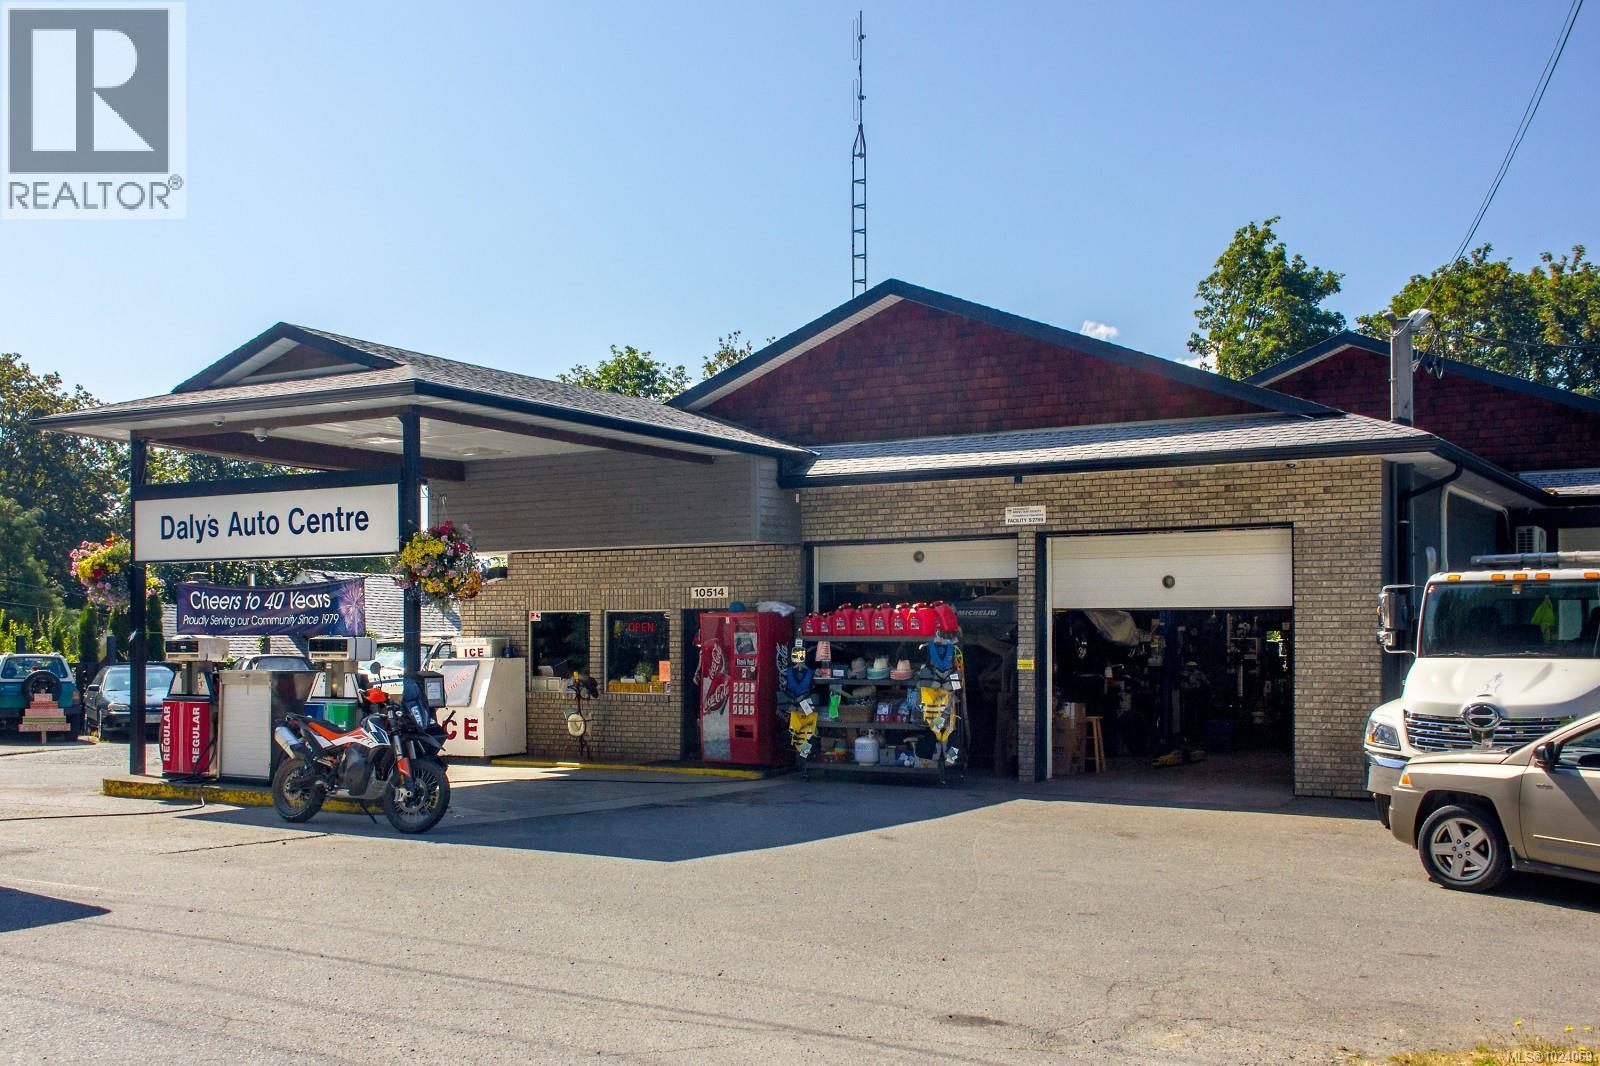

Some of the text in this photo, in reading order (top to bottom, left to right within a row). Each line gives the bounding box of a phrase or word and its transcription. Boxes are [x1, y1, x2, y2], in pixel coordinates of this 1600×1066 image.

[160, 506, 369, 544] Daly's Auto Centre
[190, 591, 331, 610] Cheers to 40 Years
[694, 588, 725, 598] 10514
[183, 613, 339, 628] Proudly Serving our Community Since 1979
[628, 622, 655, 633] OPEN
[464, 648, 484, 657] ICE
[163, 706, 171, 761] REGULAR
[191, 707, 200, 763] REGULAR
[443, 717, 478, 741] CE
